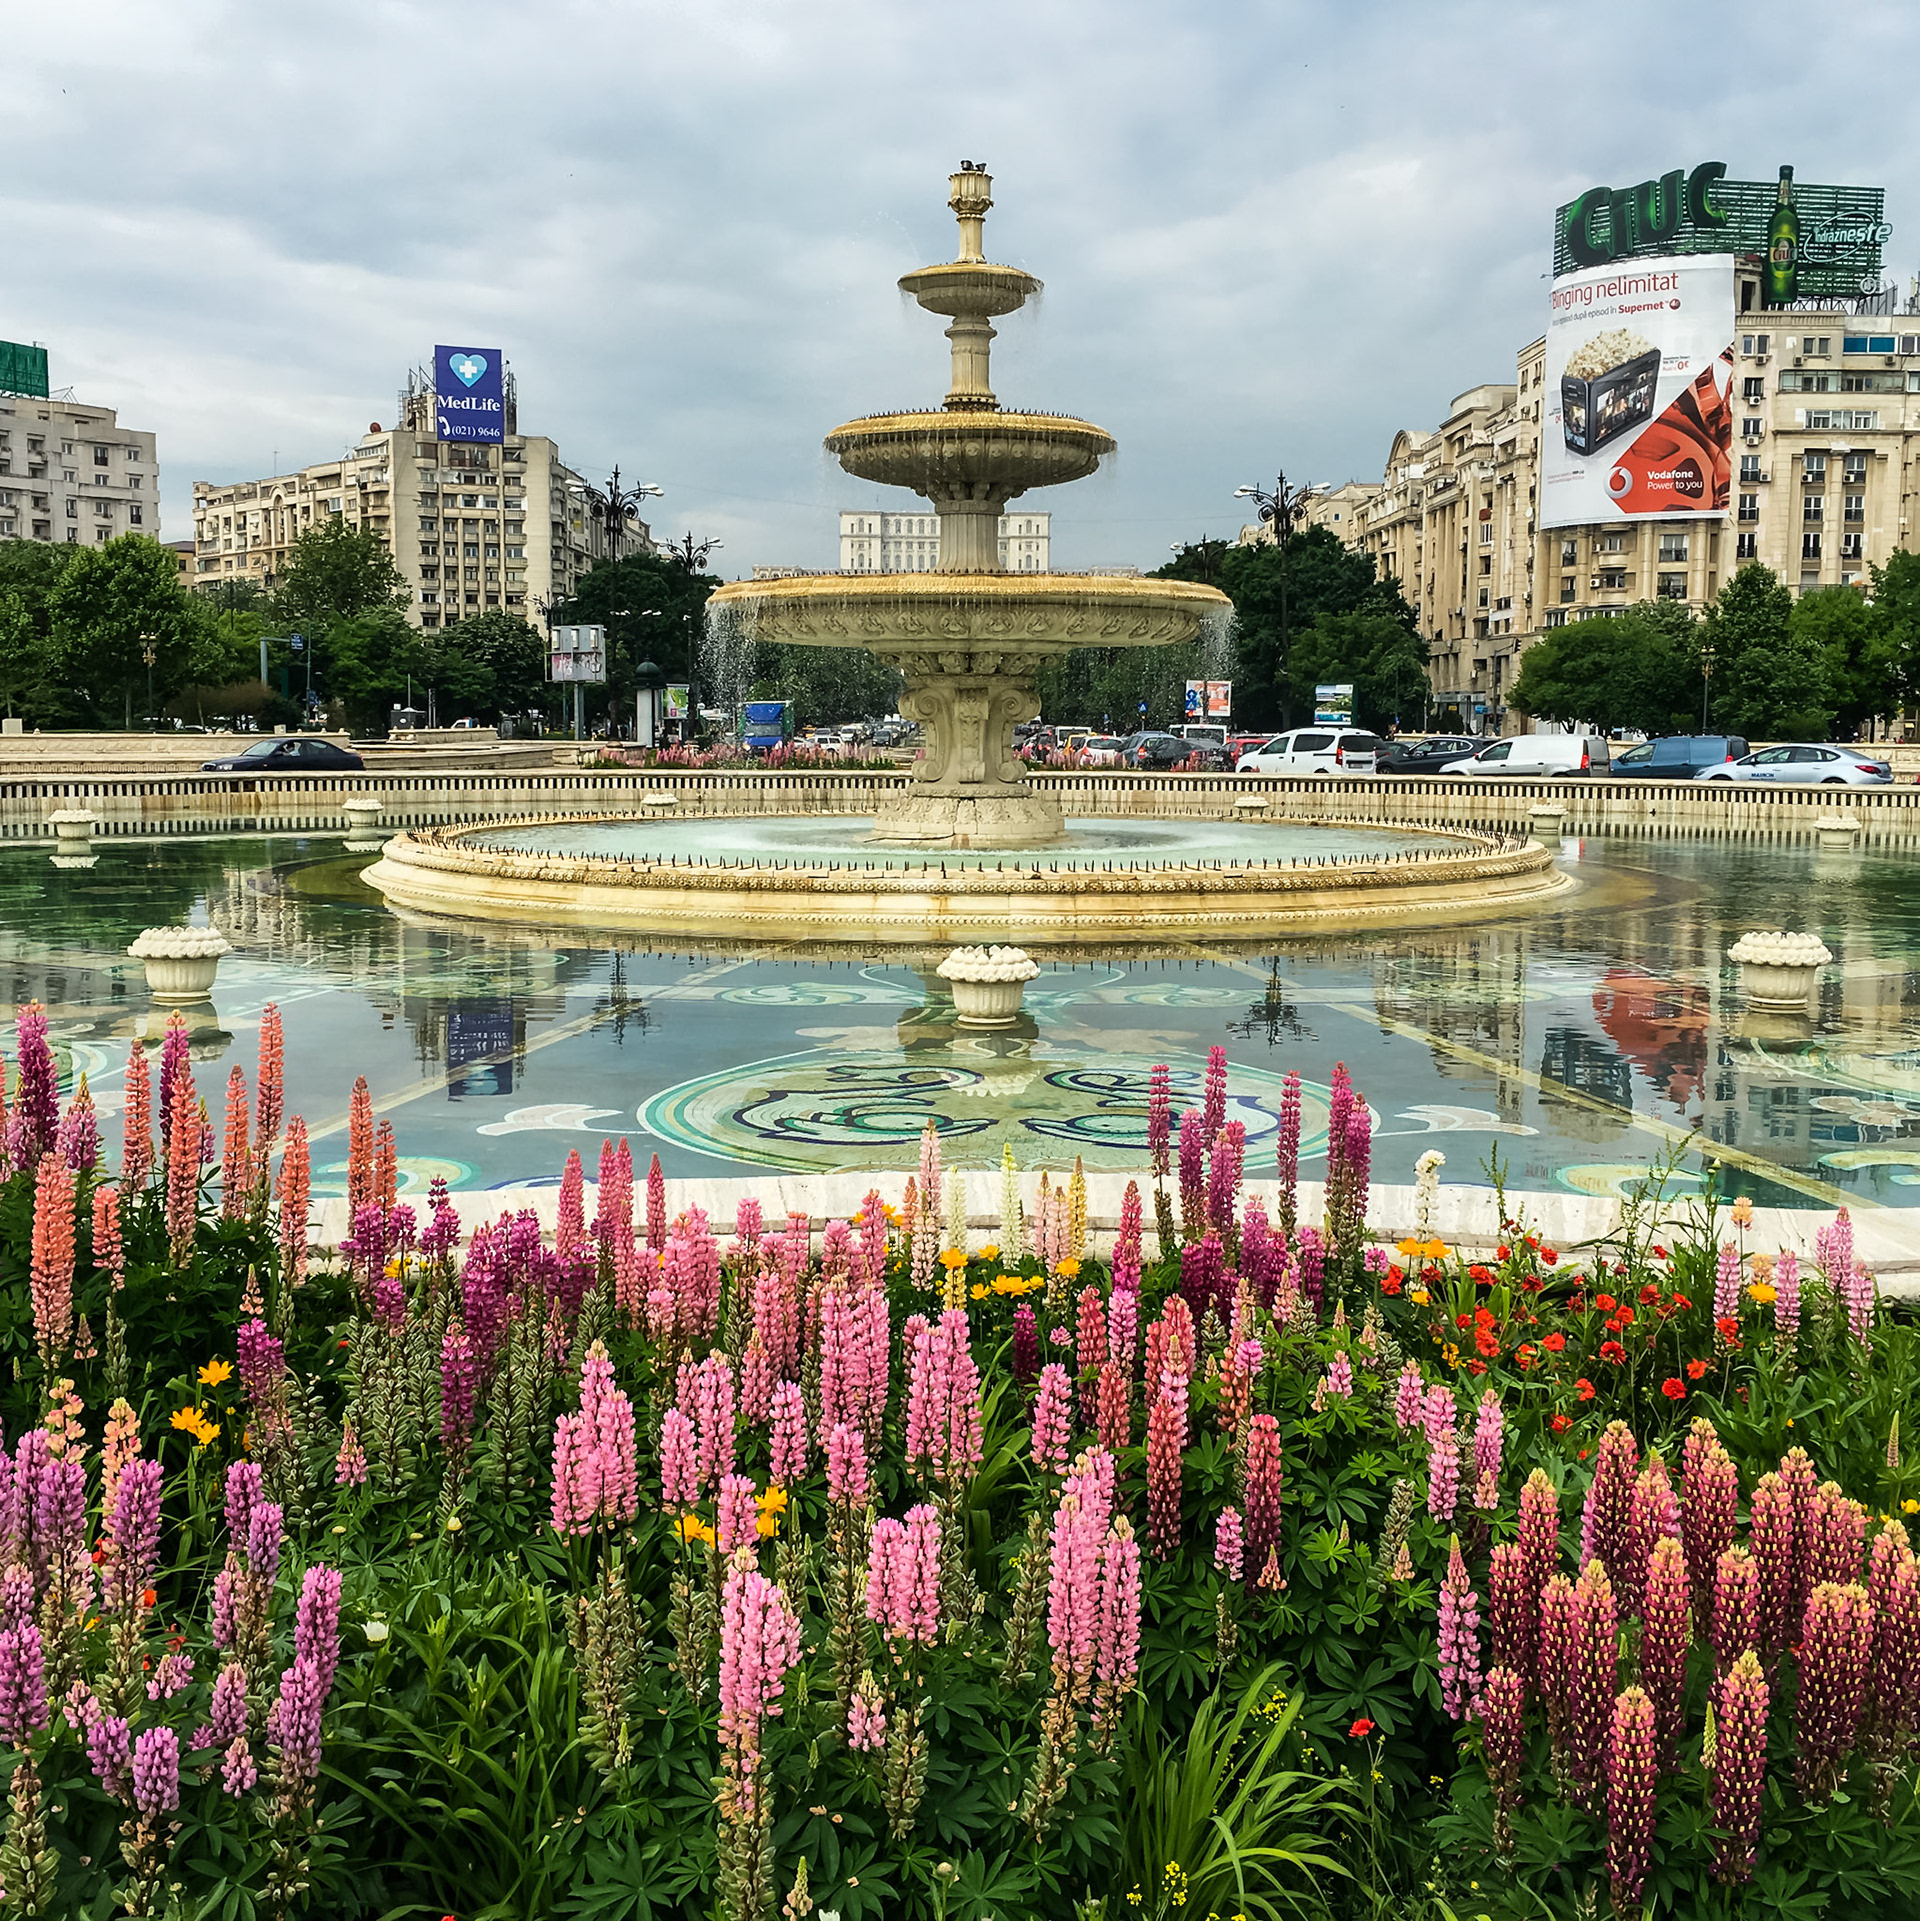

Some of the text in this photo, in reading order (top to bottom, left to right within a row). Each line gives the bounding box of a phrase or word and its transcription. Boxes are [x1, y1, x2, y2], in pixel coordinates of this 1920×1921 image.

[1552, 272, 1679, 310] Binging nelimitat
[1618, 301, 1664, 314] Supernet
[437, 395, 500, 412] MedLife
[452, 426, 500, 437] (021) 9646
[1647, 470, 1694, 480] Vodafone
[1647, 481, 1703, 491] Power to you
